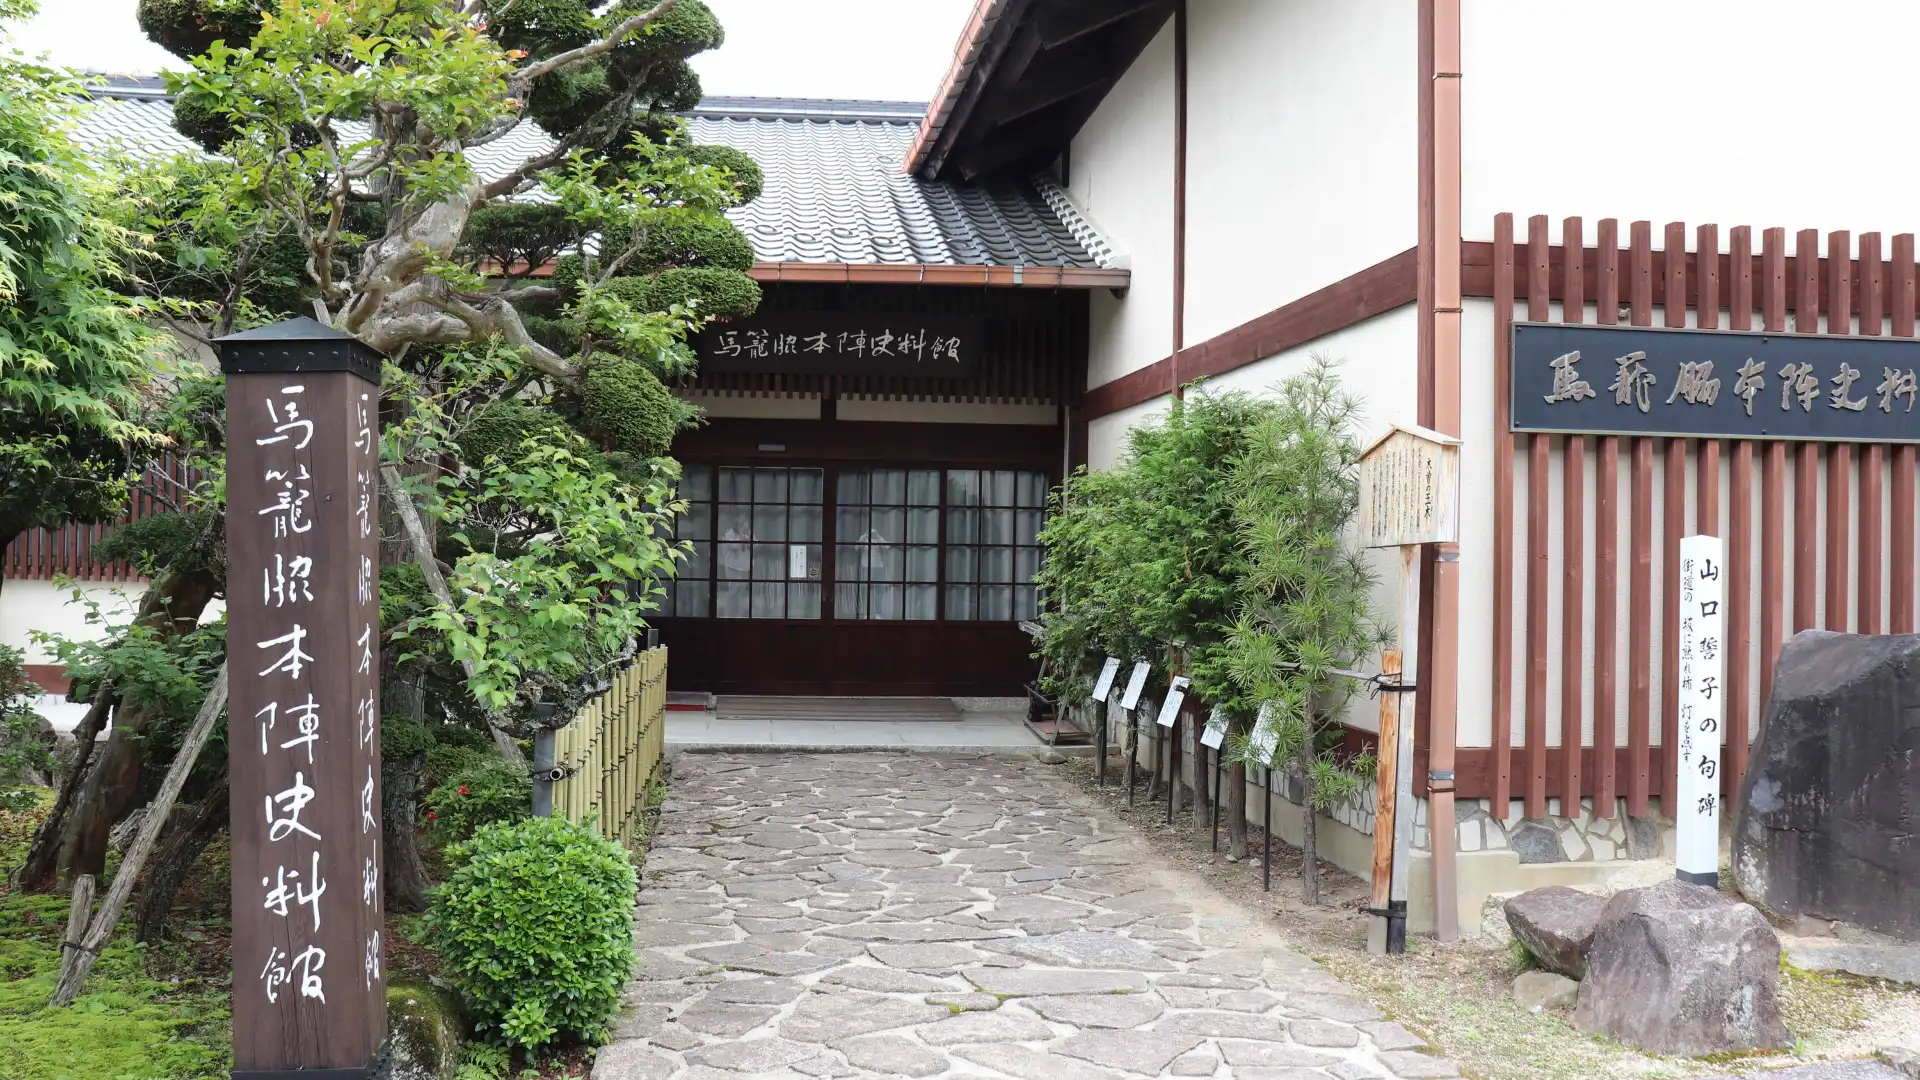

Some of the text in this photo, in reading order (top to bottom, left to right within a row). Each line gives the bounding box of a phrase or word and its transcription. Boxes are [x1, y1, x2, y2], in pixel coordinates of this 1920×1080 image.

[714, 328, 961, 363] 馬籠脇本陣史料館
[255, 385, 326, 1004] 馬籠脇本陣史料館
[1697, 558, 1719, 817] 山口誓子の句碑
